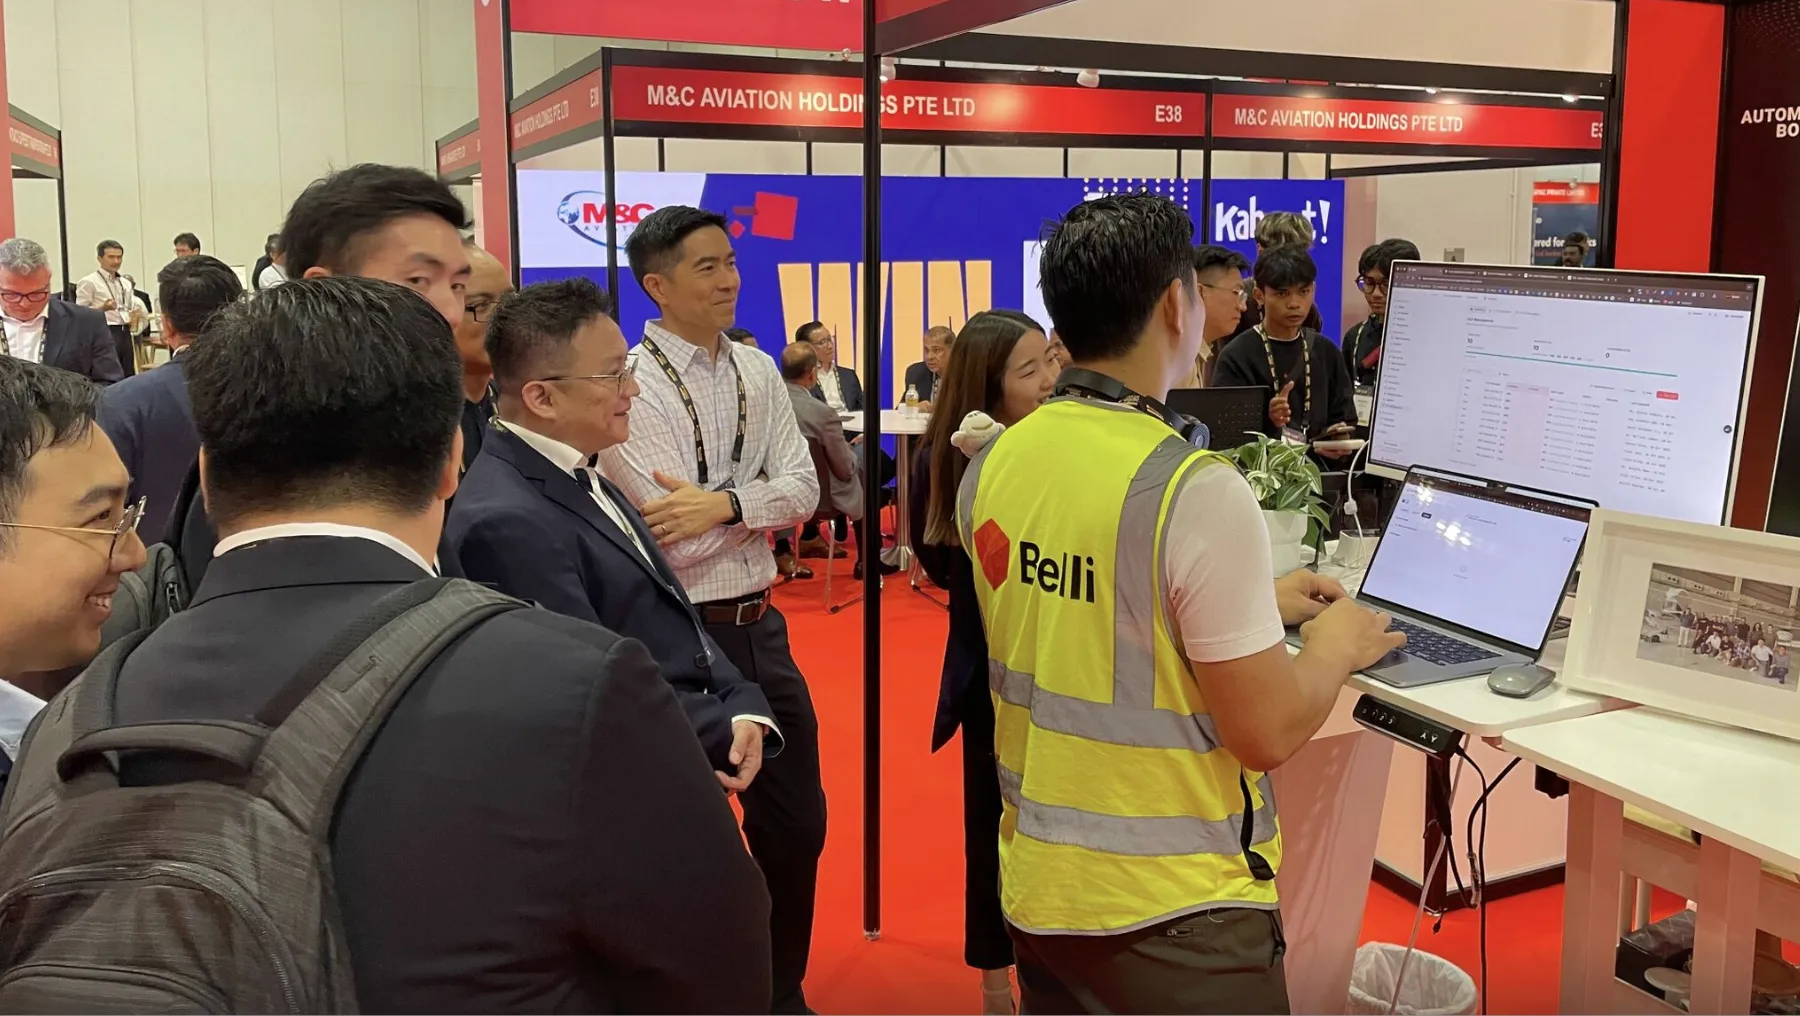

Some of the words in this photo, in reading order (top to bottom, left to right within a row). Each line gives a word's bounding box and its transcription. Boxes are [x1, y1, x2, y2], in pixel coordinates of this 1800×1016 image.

[647, 84, 695, 107] M&C
[700, 87, 792, 110] AVIATION
[903, 95, 938, 115] PTE
[943, 97, 976, 116] LTD
[1155, 104, 1182, 123] E38
[1235, 108, 1267, 126] M&C
[1270, 109, 1335, 128] AVIATION
[1338, 112, 1408, 131] HOLDINGS
[1411, 115, 1437, 132] PTE
[1439, 116, 1463, 132] LTD
[1776, 122, 1800, 138] BO
[1215, 195, 1331, 245] Kaht!
[778, 260, 992, 410] WIN
[1019, 541, 1095, 604] Belli
